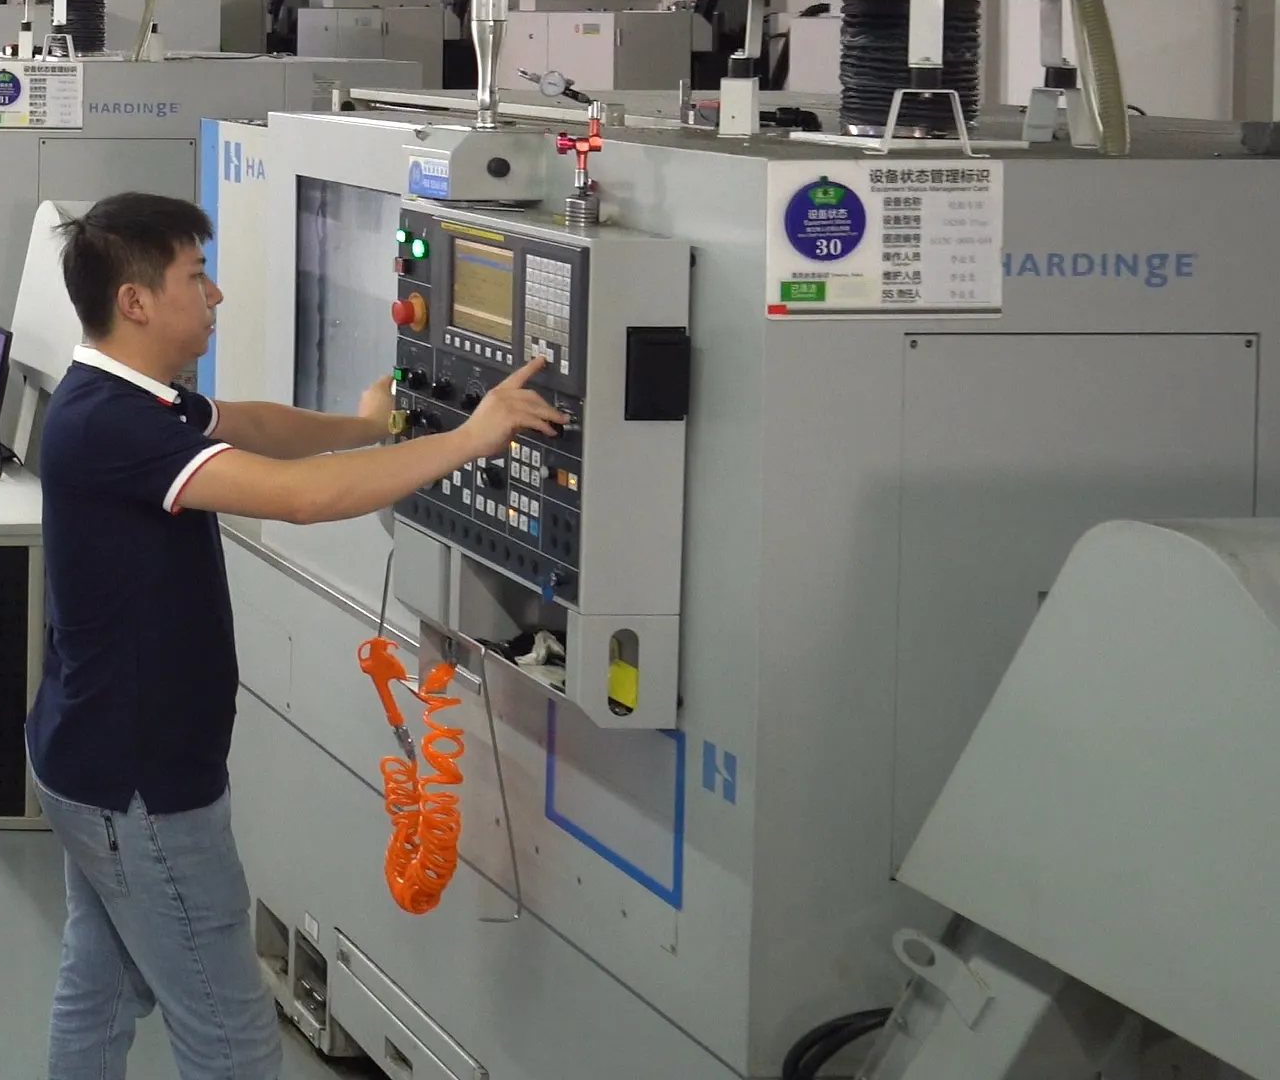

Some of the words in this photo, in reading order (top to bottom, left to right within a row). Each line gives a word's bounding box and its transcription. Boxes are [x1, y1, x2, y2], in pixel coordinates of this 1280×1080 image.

[869, 169, 991, 184] 设备状态管理标识
[815, 238, 842, 256] 30
